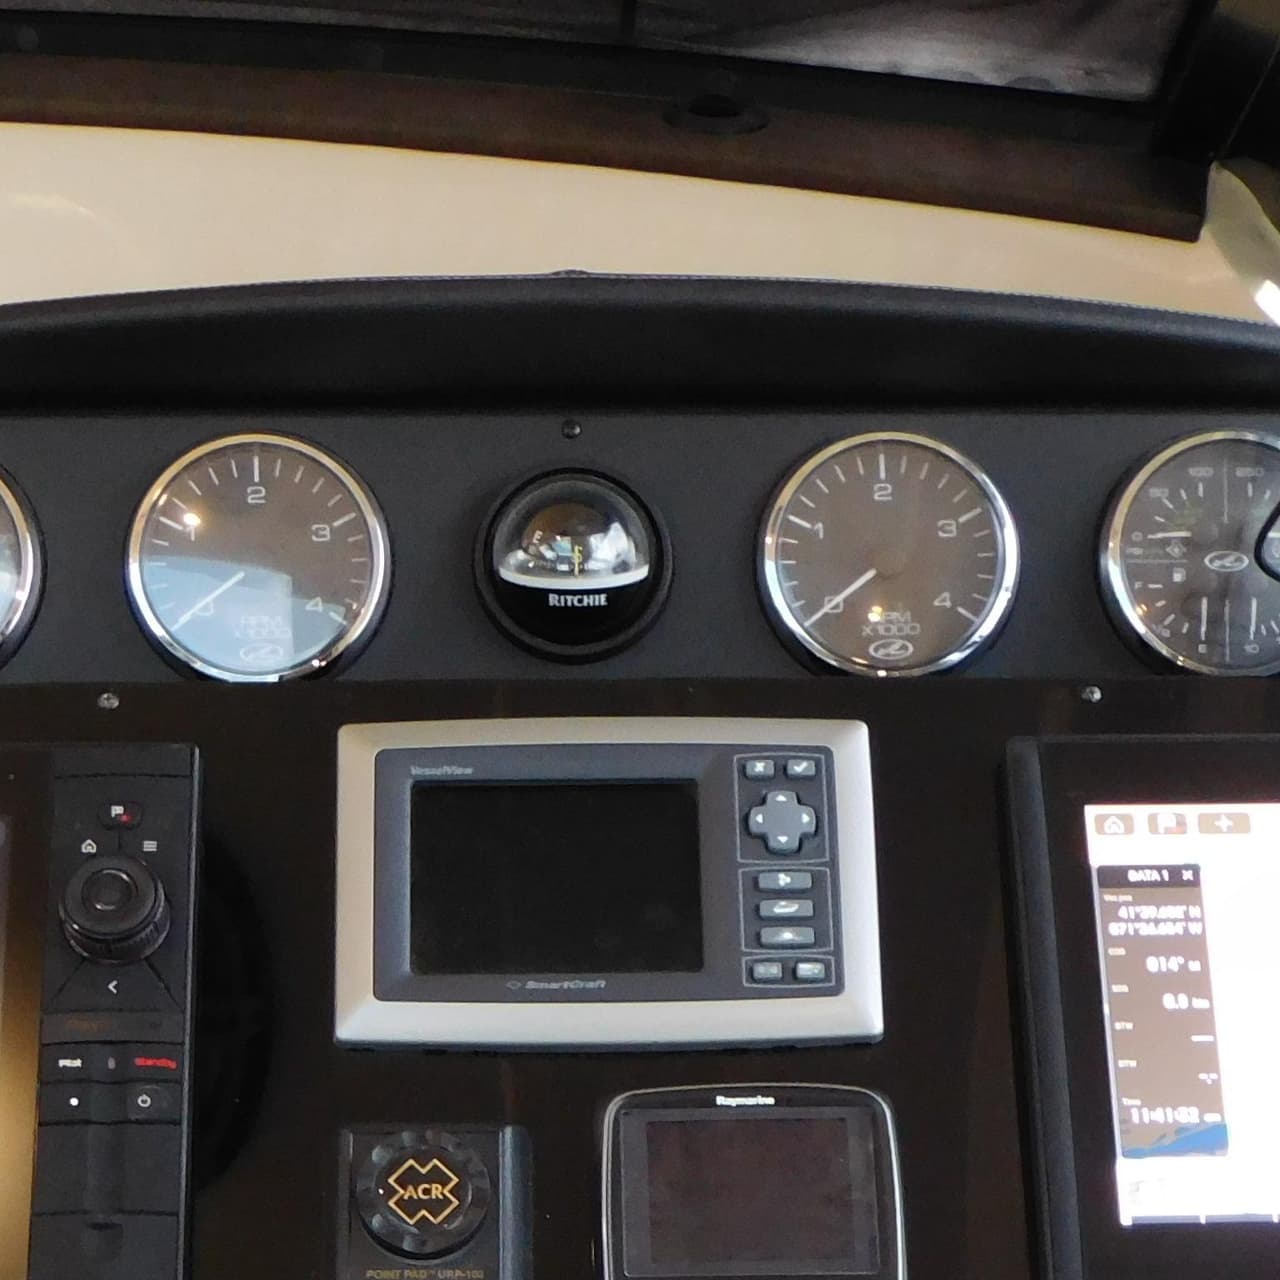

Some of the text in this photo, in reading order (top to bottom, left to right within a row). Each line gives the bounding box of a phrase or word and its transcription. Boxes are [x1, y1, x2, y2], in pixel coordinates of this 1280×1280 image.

[247, 486, 266, 503] 2
[873, 483, 893, 501] 2
[311, 524, 331, 541] 3
[813, 522, 824, 540] 1
[937, 520, 957, 538] 3
[305, 597, 323, 613] 4
[548, 593, 608, 607] RITCHIE
[933, 592, 952, 609] 4
[403, 1183, 444, 1200] ACR
